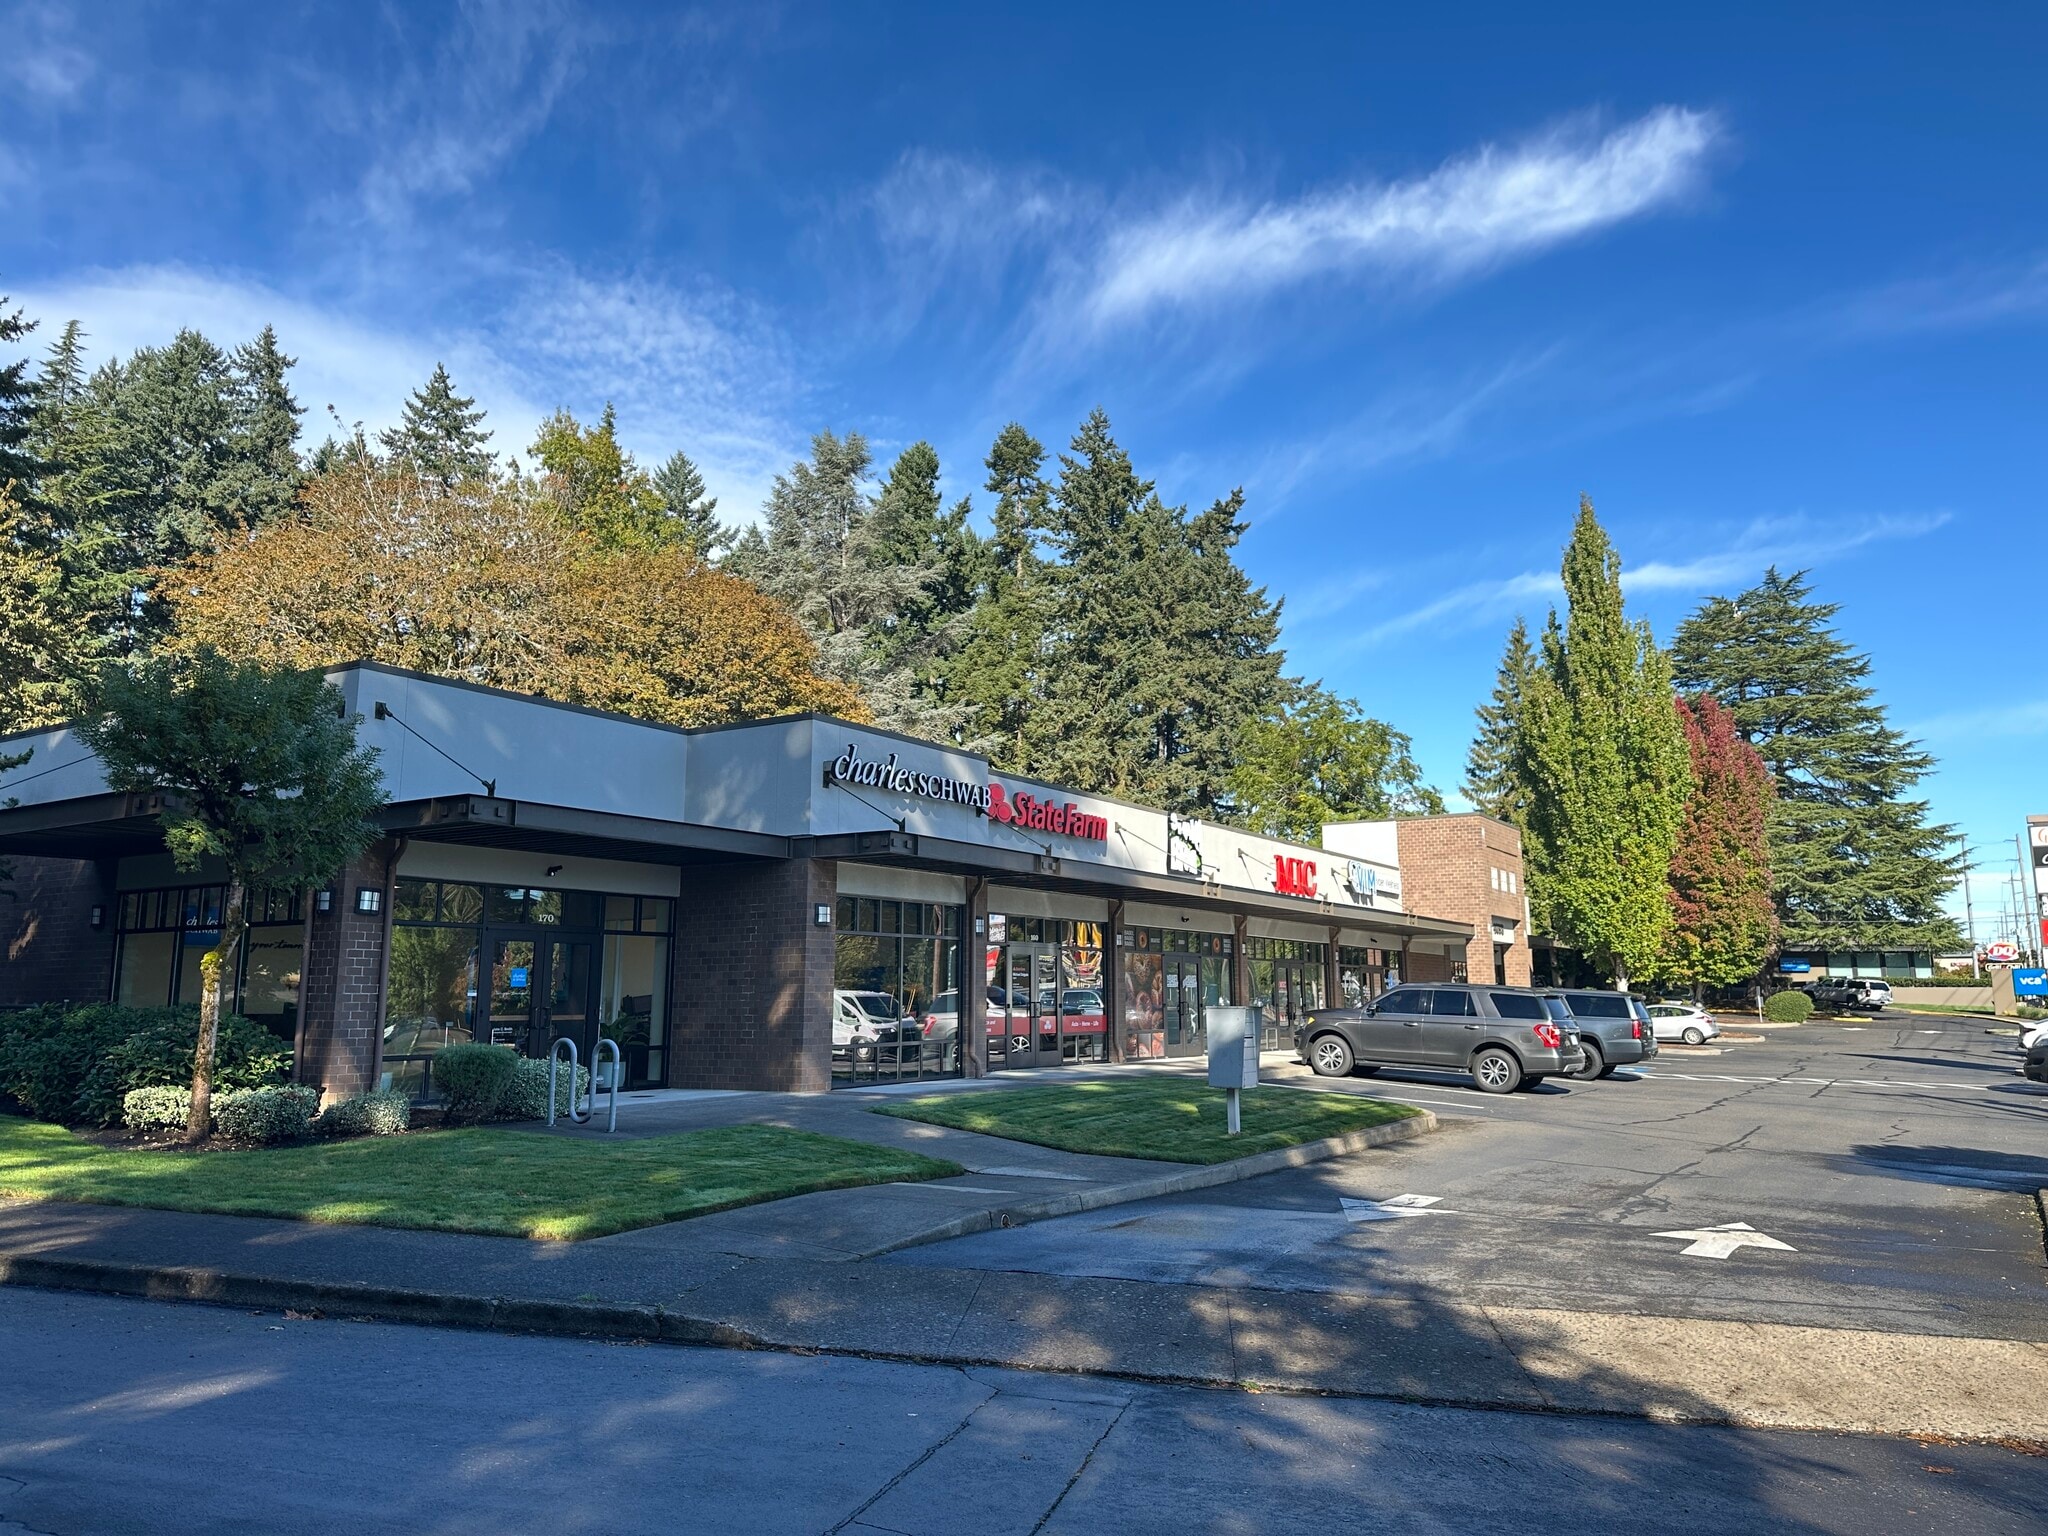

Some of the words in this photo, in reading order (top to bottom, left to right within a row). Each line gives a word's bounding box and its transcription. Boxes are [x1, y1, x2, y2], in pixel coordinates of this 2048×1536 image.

[833, 744, 916, 793] charles
[919, 774, 992, 808] SCHWAB
[538, 914, 555, 923] 170
[1993, 946, 2014, 956] DQ
[2020, 976, 2042, 985] vca
